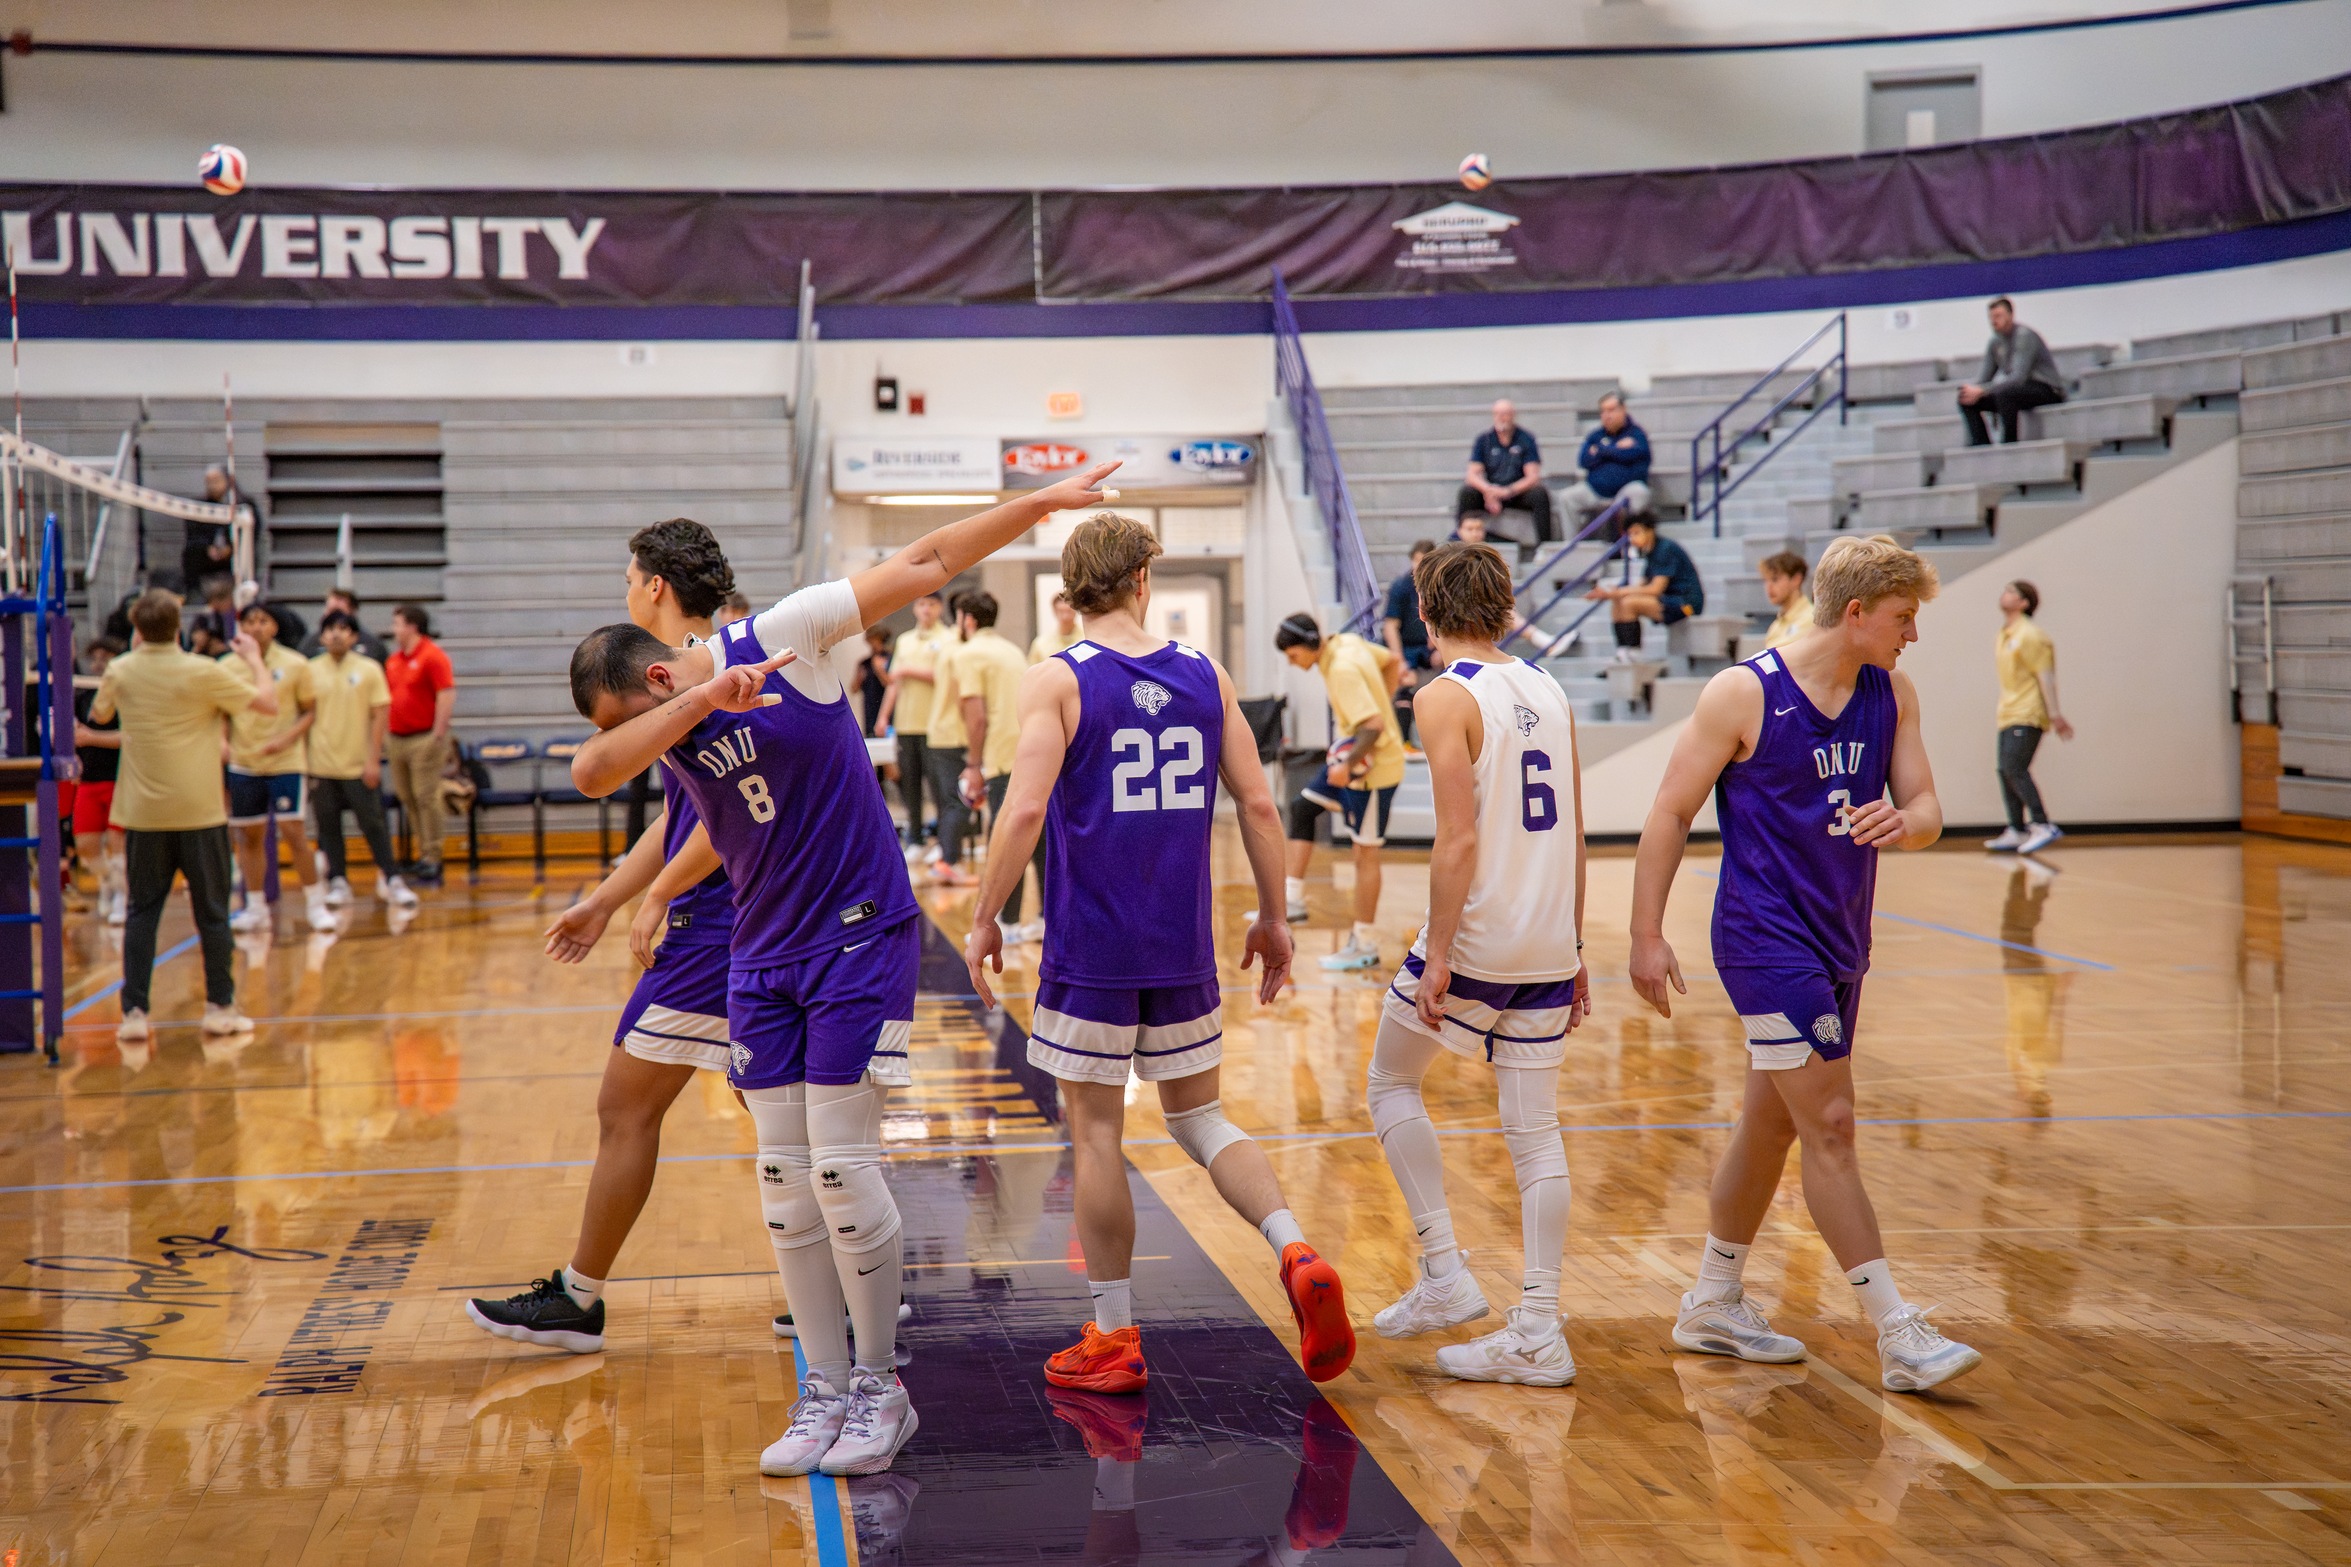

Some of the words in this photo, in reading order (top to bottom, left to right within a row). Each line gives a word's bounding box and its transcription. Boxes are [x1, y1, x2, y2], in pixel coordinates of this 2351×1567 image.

[2, 211, 606, 279] UNIVERSITY
[697, 726, 757, 778] ONU
[1111, 726, 1205, 812] 22
[1813, 742, 1865, 779] ONU
[737, 774, 776, 824] 8
[1521, 749, 1558, 832] 6
[1828, 789, 1851, 836] 3
[257, 1345, 374, 1397] RALPH
[319, 1252, 418, 1293] HODGE
